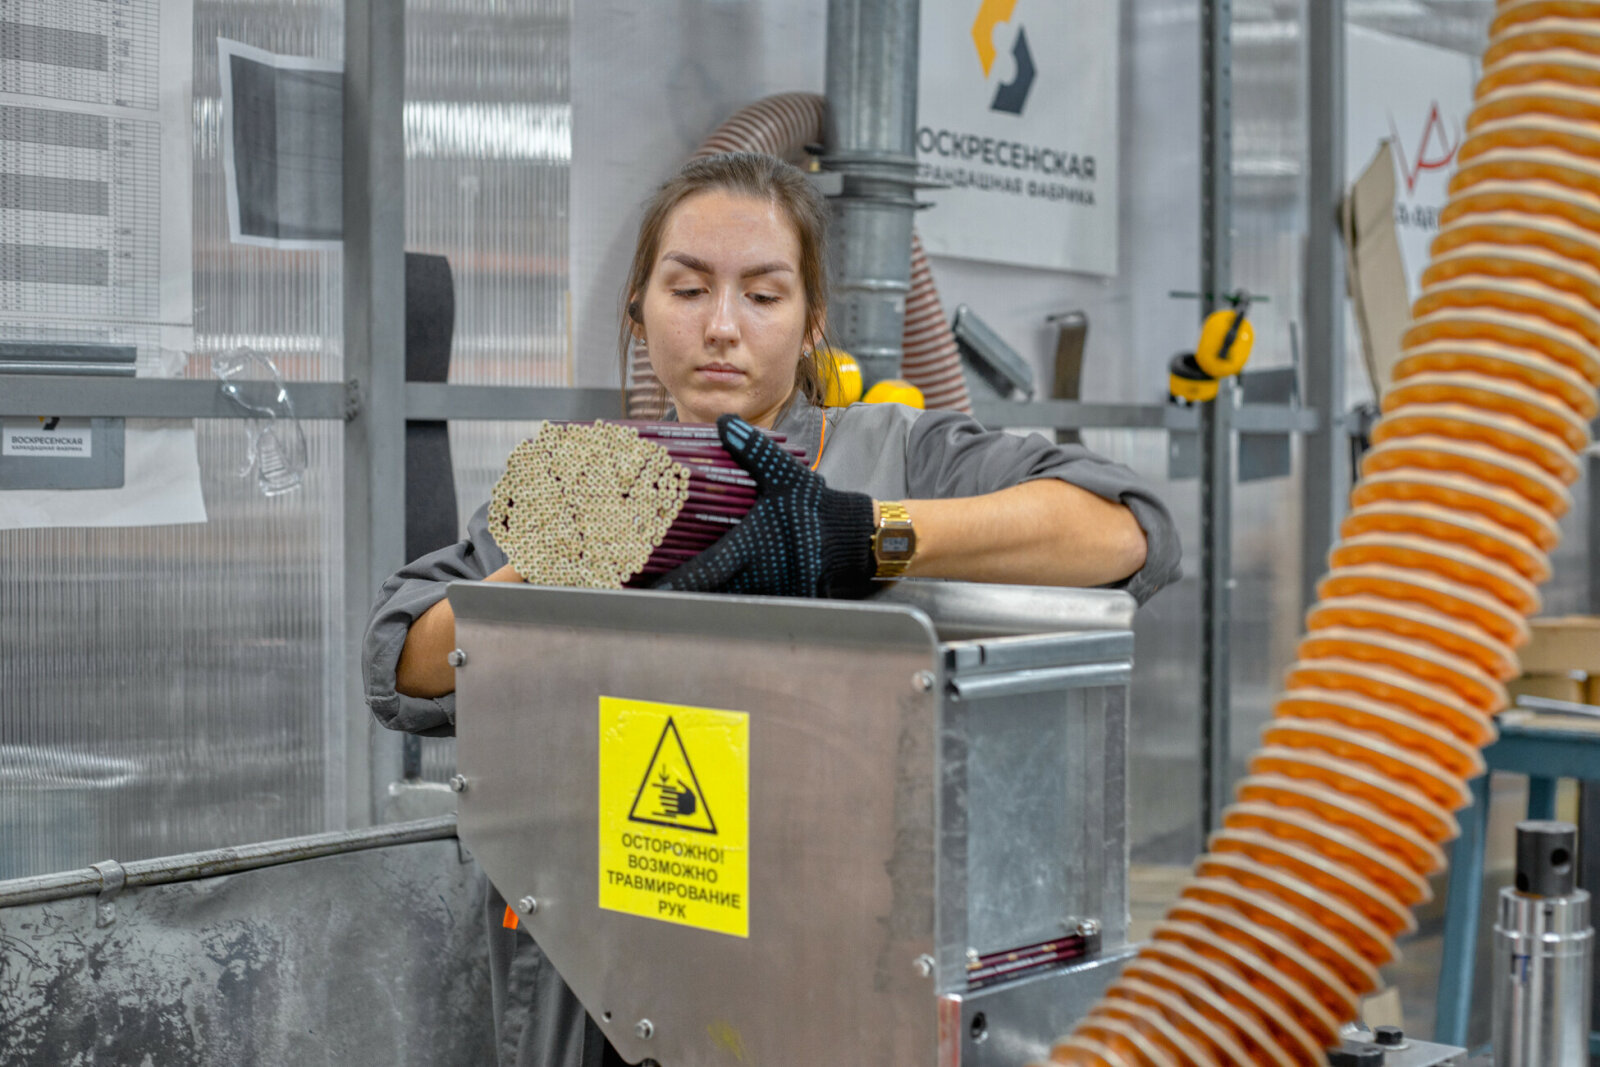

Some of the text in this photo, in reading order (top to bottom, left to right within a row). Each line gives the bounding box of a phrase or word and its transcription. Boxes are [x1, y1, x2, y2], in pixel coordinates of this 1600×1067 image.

[917, 127, 1096, 177] ОСКРЕСЕНСКАЯ
[917, 165, 1022, 194] РАНДАШНАЯ
[11, 436, 83, 445] ВОСКРЕСЕНСКАЯ
[622, 833, 724, 864] ОСТОРОЖНО!
[628, 854, 718, 883] ВОЗМОЖНО
[607, 870, 741, 909] ТРАВМИРОВАНИЕ
[658, 900, 686, 918] РУК
